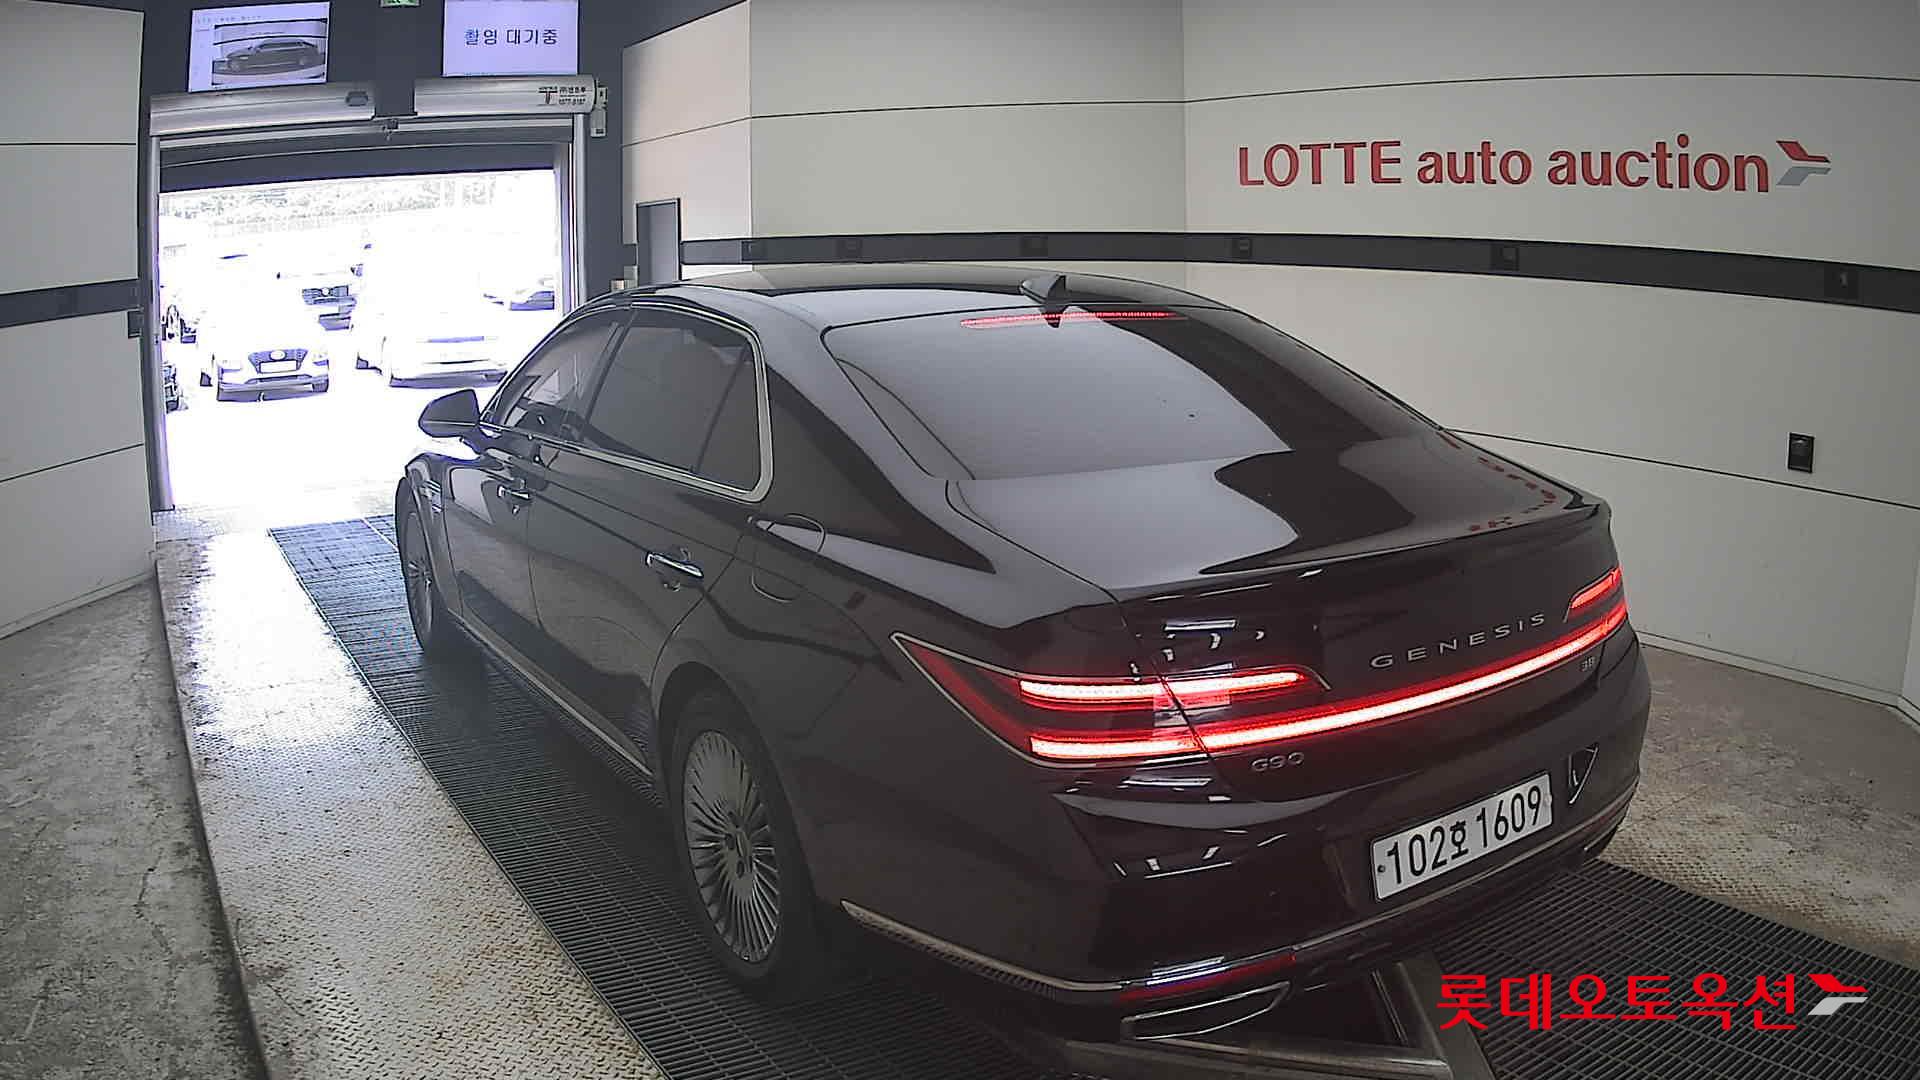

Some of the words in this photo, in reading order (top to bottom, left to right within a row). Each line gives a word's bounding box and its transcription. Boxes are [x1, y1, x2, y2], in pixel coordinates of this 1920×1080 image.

[506, 28, 557, 45] 대기중
[1239, 140, 1400, 187] LOTTE
[1417, 140, 1533, 185] auto
[1547, 134, 1769, 193] auction
[1370, 613, 1545, 669] GENESIS
[1251, 752, 1305, 772] G90
